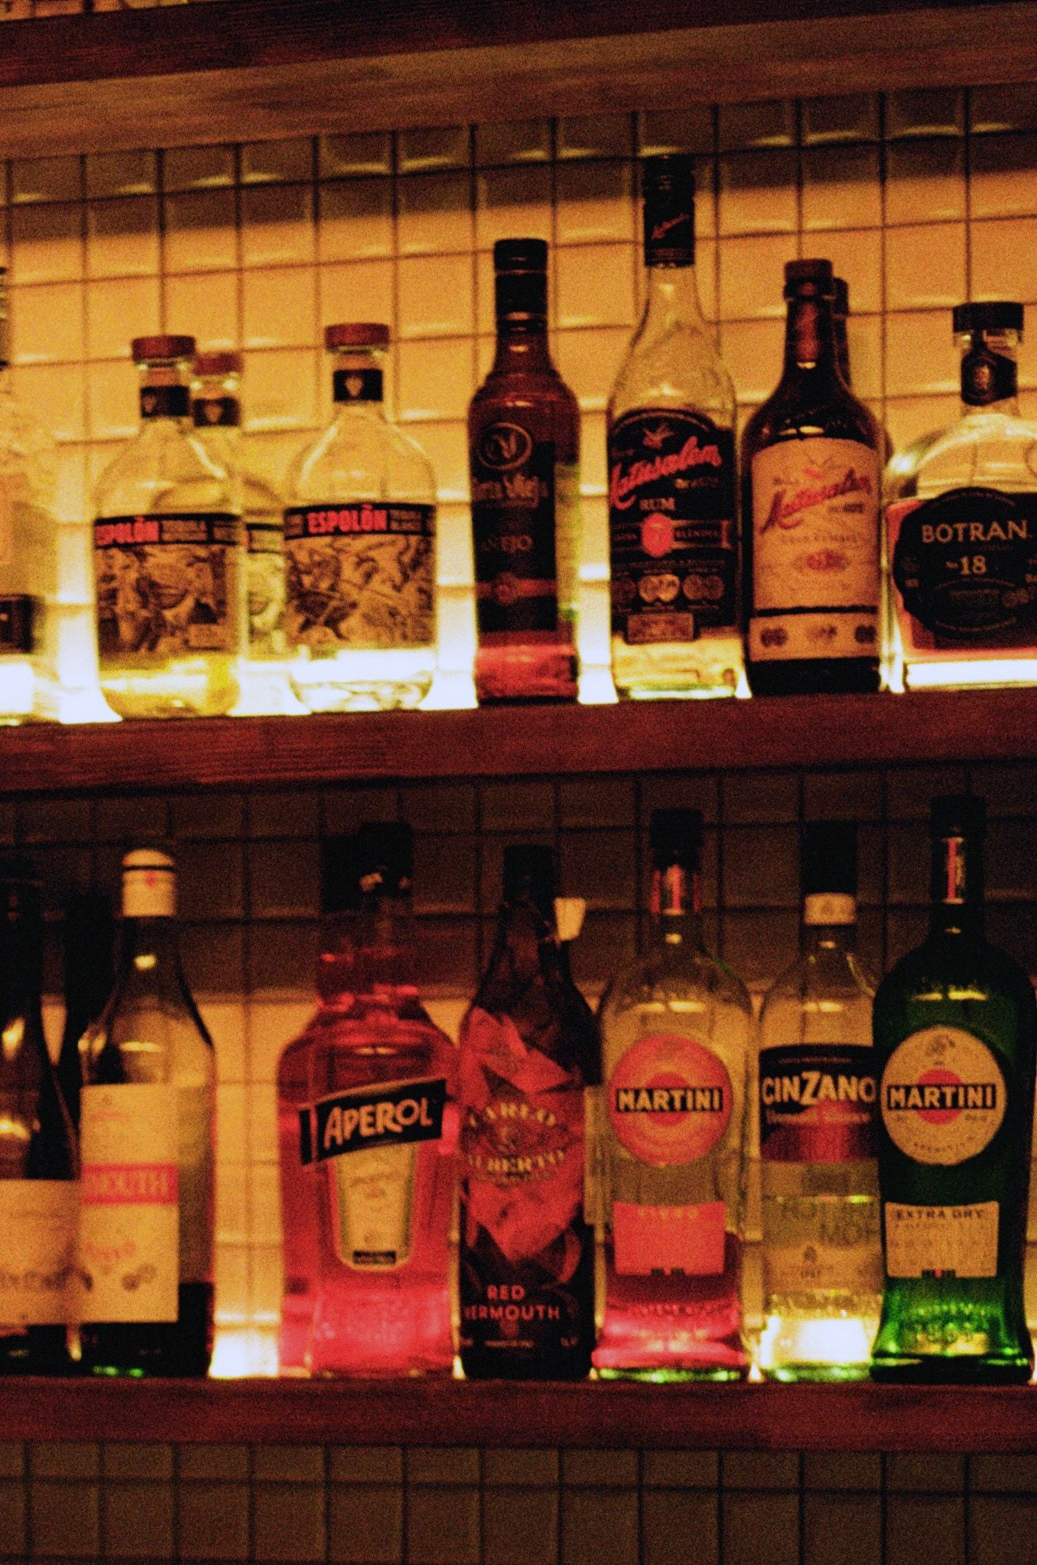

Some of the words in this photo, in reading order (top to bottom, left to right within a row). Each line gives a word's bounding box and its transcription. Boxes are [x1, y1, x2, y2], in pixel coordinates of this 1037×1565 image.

[639, 497, 675, 512] RUM
[921, 520, 1028, 544] BOTRAN
[959, 554, 988, 575] 18
[762, 1070, 877, 1106] CINZANO
[889, 1086, 994, 1109] MARTINI
[617, 1088, 722, 1112] MARTINI
[323, 1098, 434, 1150] APEROL
[487, 1284, 526, 1301] RED
